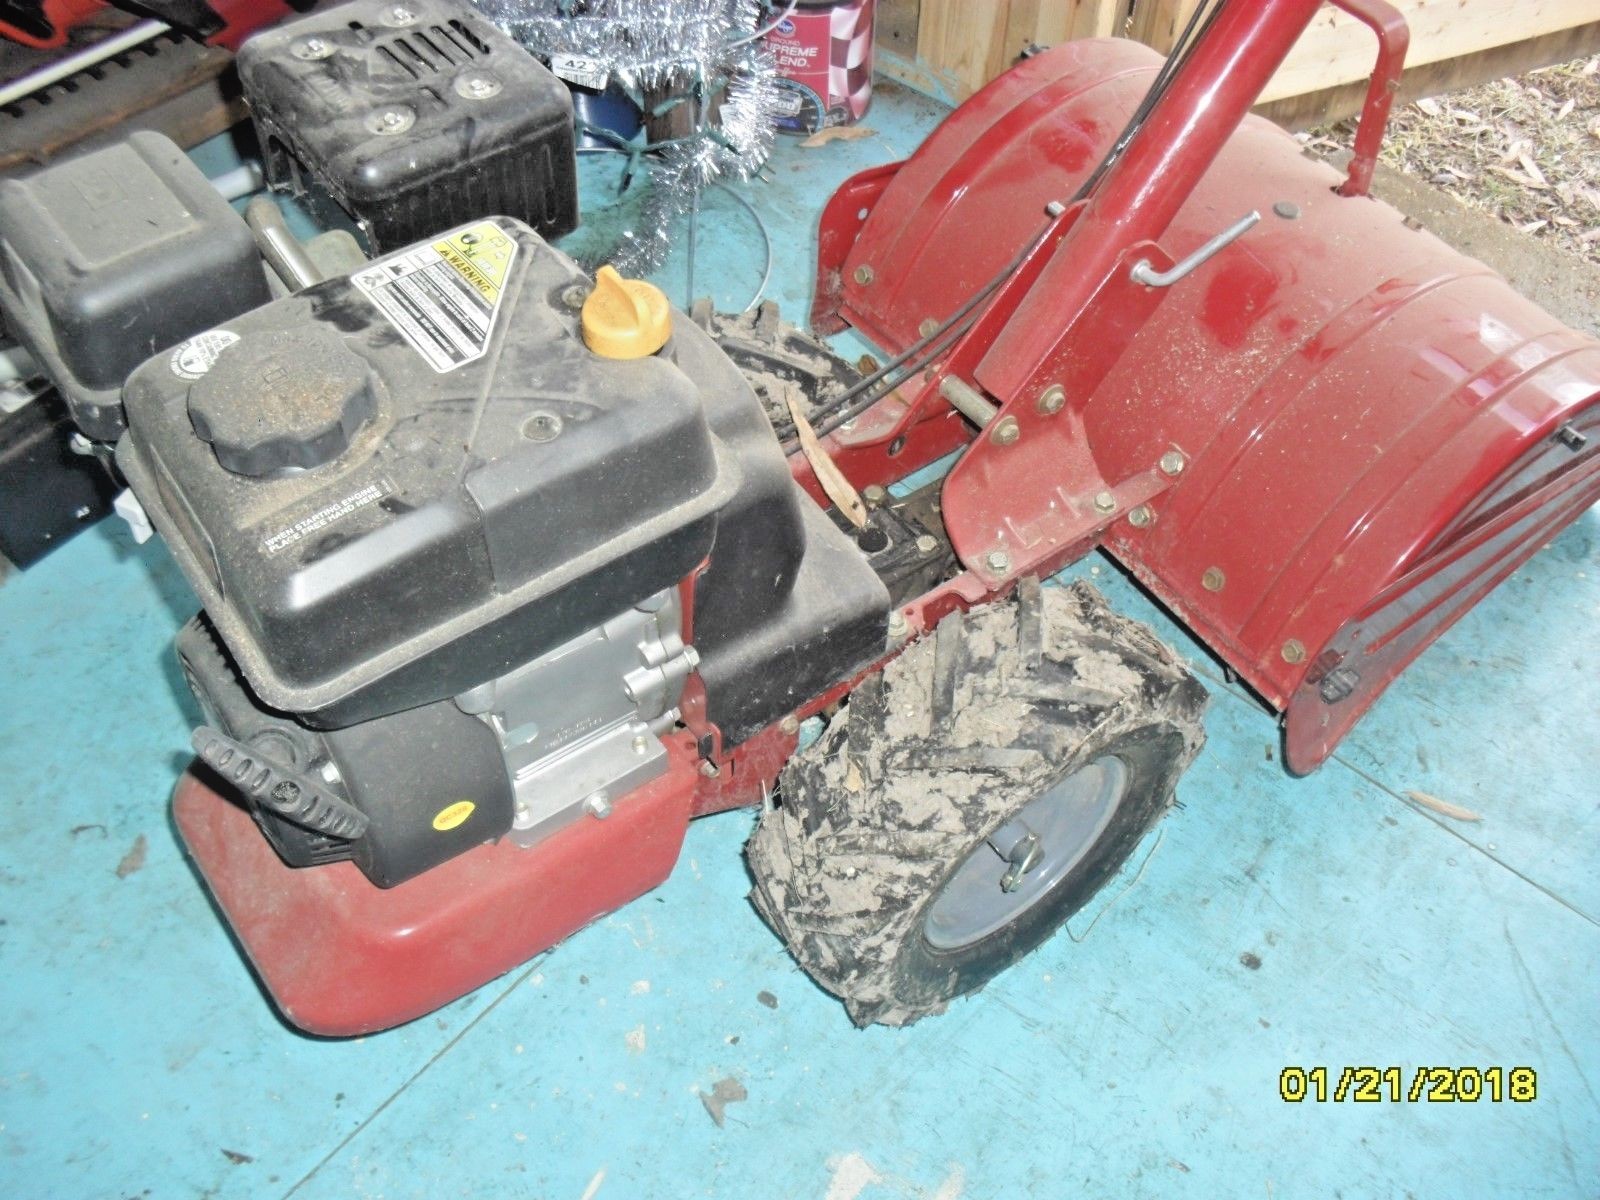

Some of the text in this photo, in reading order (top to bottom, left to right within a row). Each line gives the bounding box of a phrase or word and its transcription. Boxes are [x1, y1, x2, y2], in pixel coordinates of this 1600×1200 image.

[449, 254, 491, 293] WARNING
[265, 528, 294, 546] WHEN
[295, 504, 341, 530] STARTING
[341, 485, 377, 506] ENGINE
[268, 490, 382, 552] PLACE FREE HAND HERE
